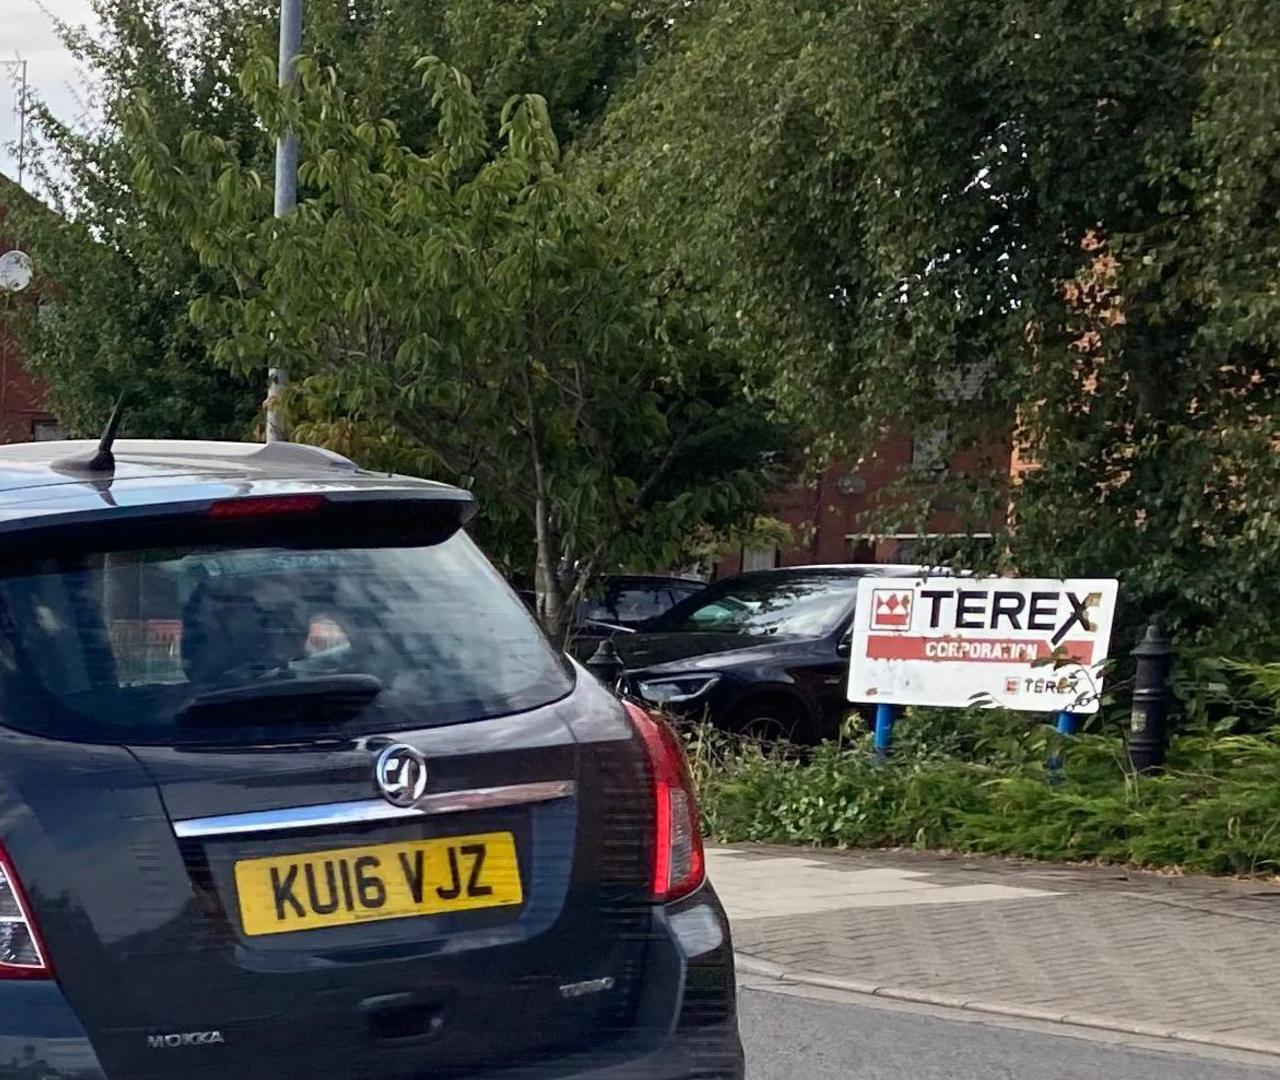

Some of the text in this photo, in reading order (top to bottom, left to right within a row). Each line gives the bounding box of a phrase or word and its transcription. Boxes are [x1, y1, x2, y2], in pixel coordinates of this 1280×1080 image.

[920, 590, 1102, 645] TEREX
[270, 843, 493, 920] KU16 VJZ
[146, 1030, 225, 1048] MOKKA
